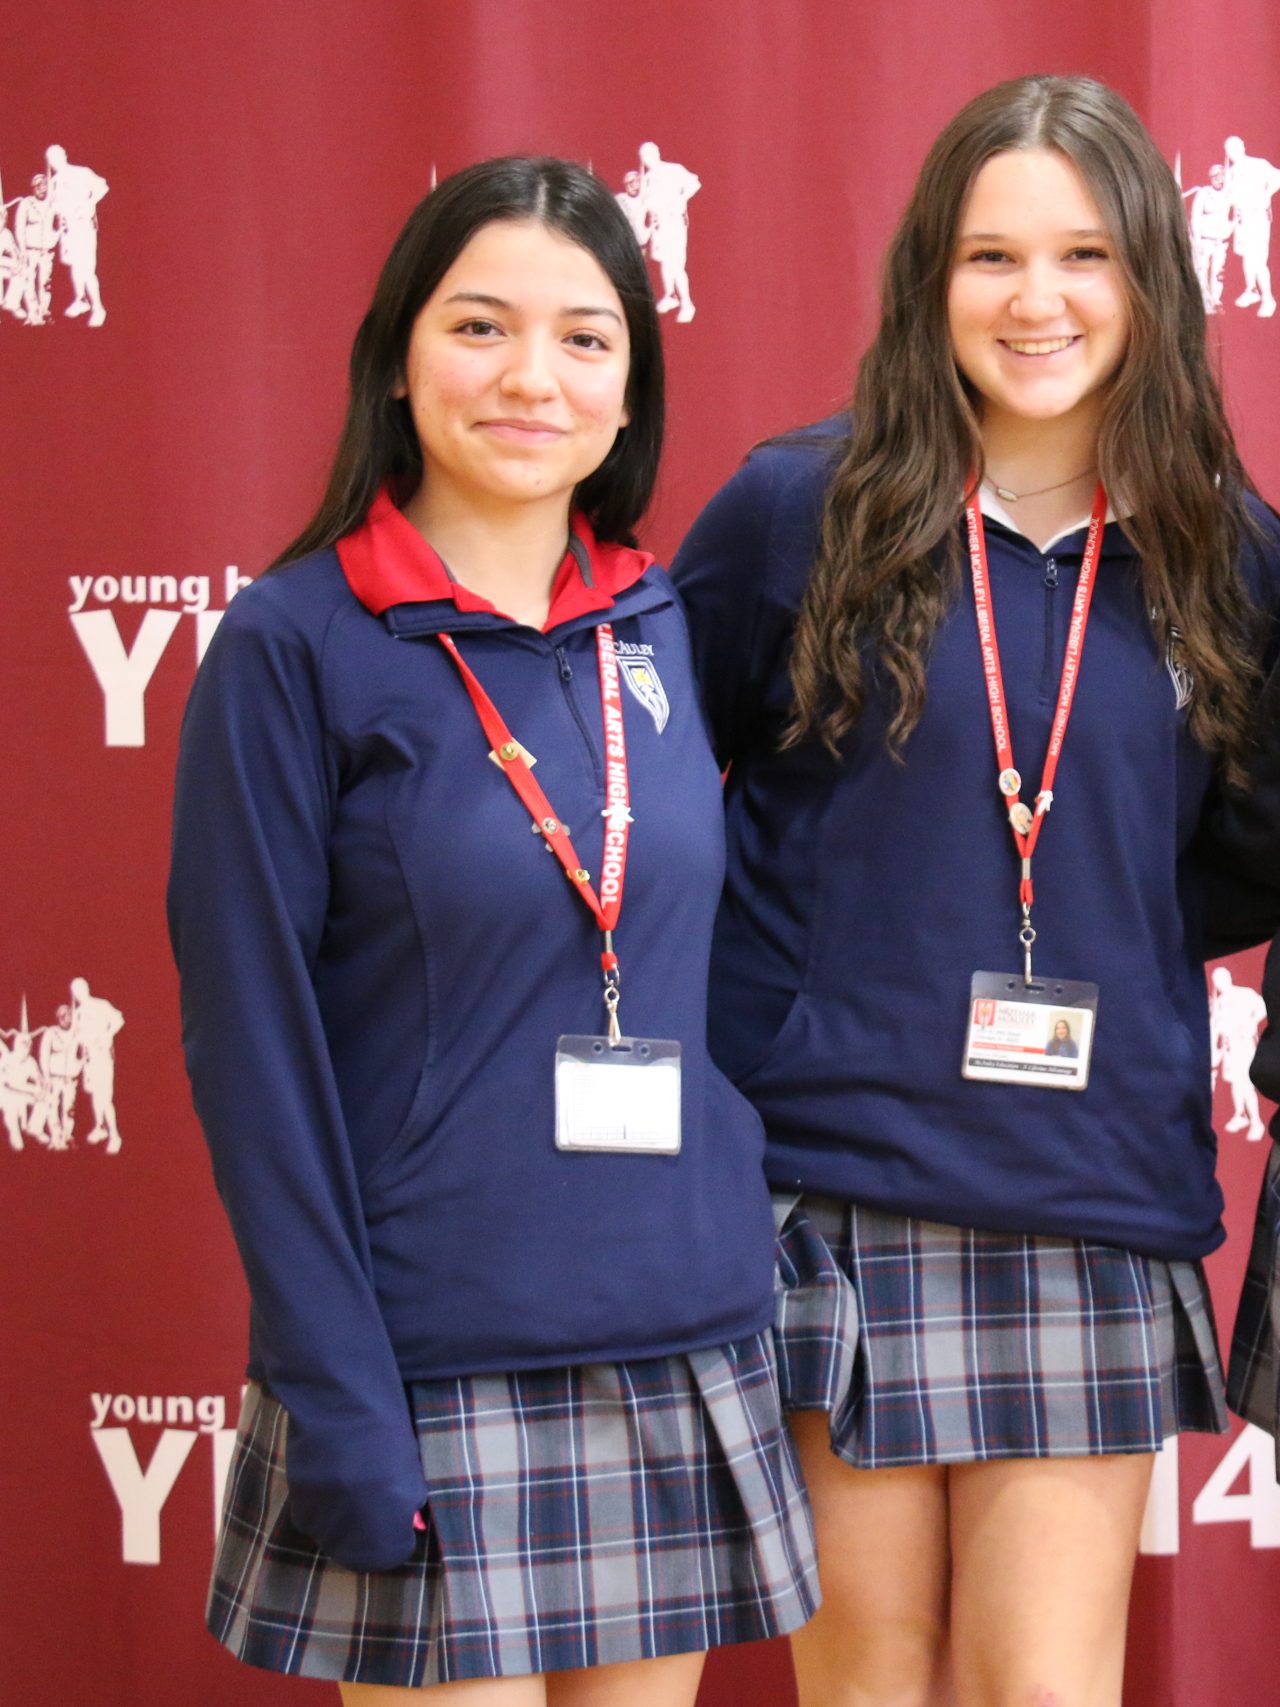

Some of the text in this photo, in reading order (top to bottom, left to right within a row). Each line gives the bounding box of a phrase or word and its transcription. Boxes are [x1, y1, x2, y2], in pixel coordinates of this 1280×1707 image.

[966, 507, 980, 552] MOTHER
[1085, 517, 1100, 556] SCHOOL
[1079, 557, 1093, 584] HIGH
[68, 575, 210, 613] young
[1073, 585, 1088, 613] ARTS
[976, 604, 992, 645] LIBERAL
[1068, 615, 1084, 656] LIBERAL
[983, 645, 997, 674] ARTS
[987, 676, 1001, 703] HIGH
[605, 704, 625, 758] ARTS
[992, 706, 1008, 753] SCHOOL
[1050, 708, 1068, 756] MOTHER
[601, 812, 627, 910] SCHOOL
[90, 1393, 226, 1433] young
